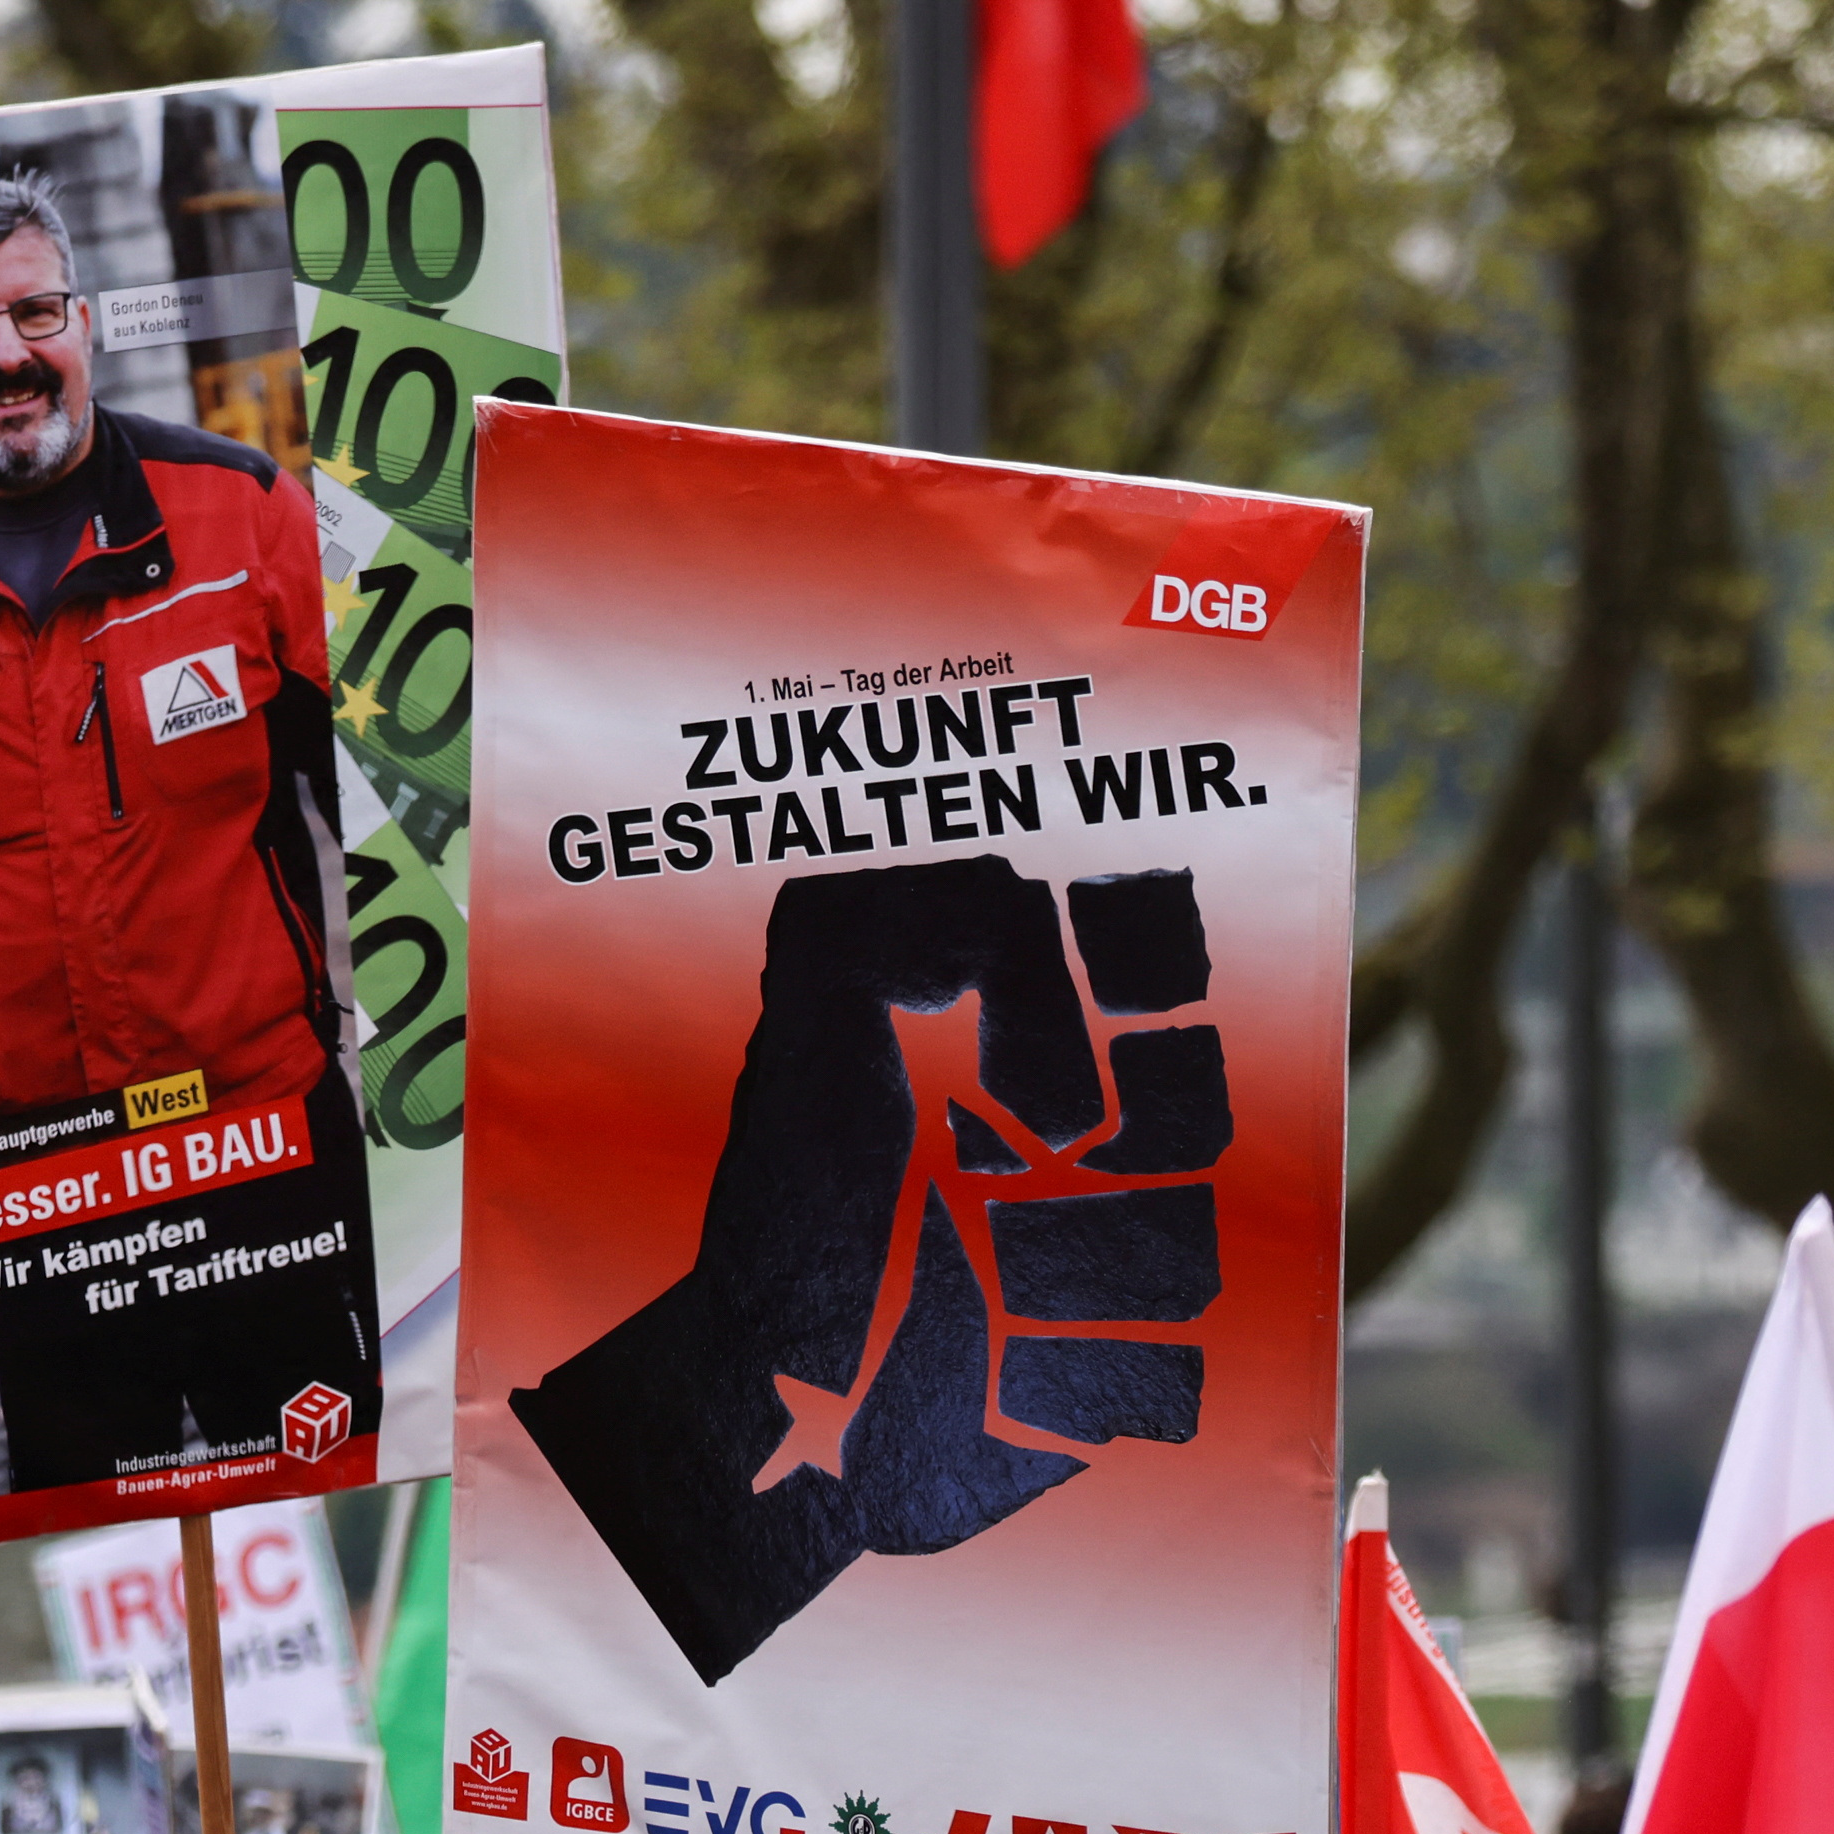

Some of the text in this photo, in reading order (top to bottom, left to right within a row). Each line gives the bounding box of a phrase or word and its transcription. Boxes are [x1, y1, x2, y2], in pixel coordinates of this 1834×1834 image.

[111, 298, 158, 316] Gordon
[114, 317, 190, 338] aus Koblenz
[315, 500, 343, 527] 2002
[1150, 575, 1268, 633] DGB
[745, 681, 766, 705] 1.
[771, 672, 815, 702] Mai
[841, 668, 886, 698] Tag
[892, 662, 935, 691] der
[939, 651, 1014, 683] Arbeit
[160, 698, 237, 737] MERTGEN
[681, 676, 1092, 789] ZUKUNFT
[549, 742, 1267, 884] GESTALTEN WIR.
[131, 1082, 200, 1119] West
[121, 1142, 173, 1197] IG
[184, 1113, 298, 1182] BAU.
[43, 1217, 206, 1278] kämpfen
[85, 1220, 347, 1313] für Tariftreue!
[116, 1436, 277, 1474] Industriegewerkschaft
[117, 1457, 277, 1496] Bauen-Agrar-Umwelt
[566, 1802, 614, 1822] IGBCE
